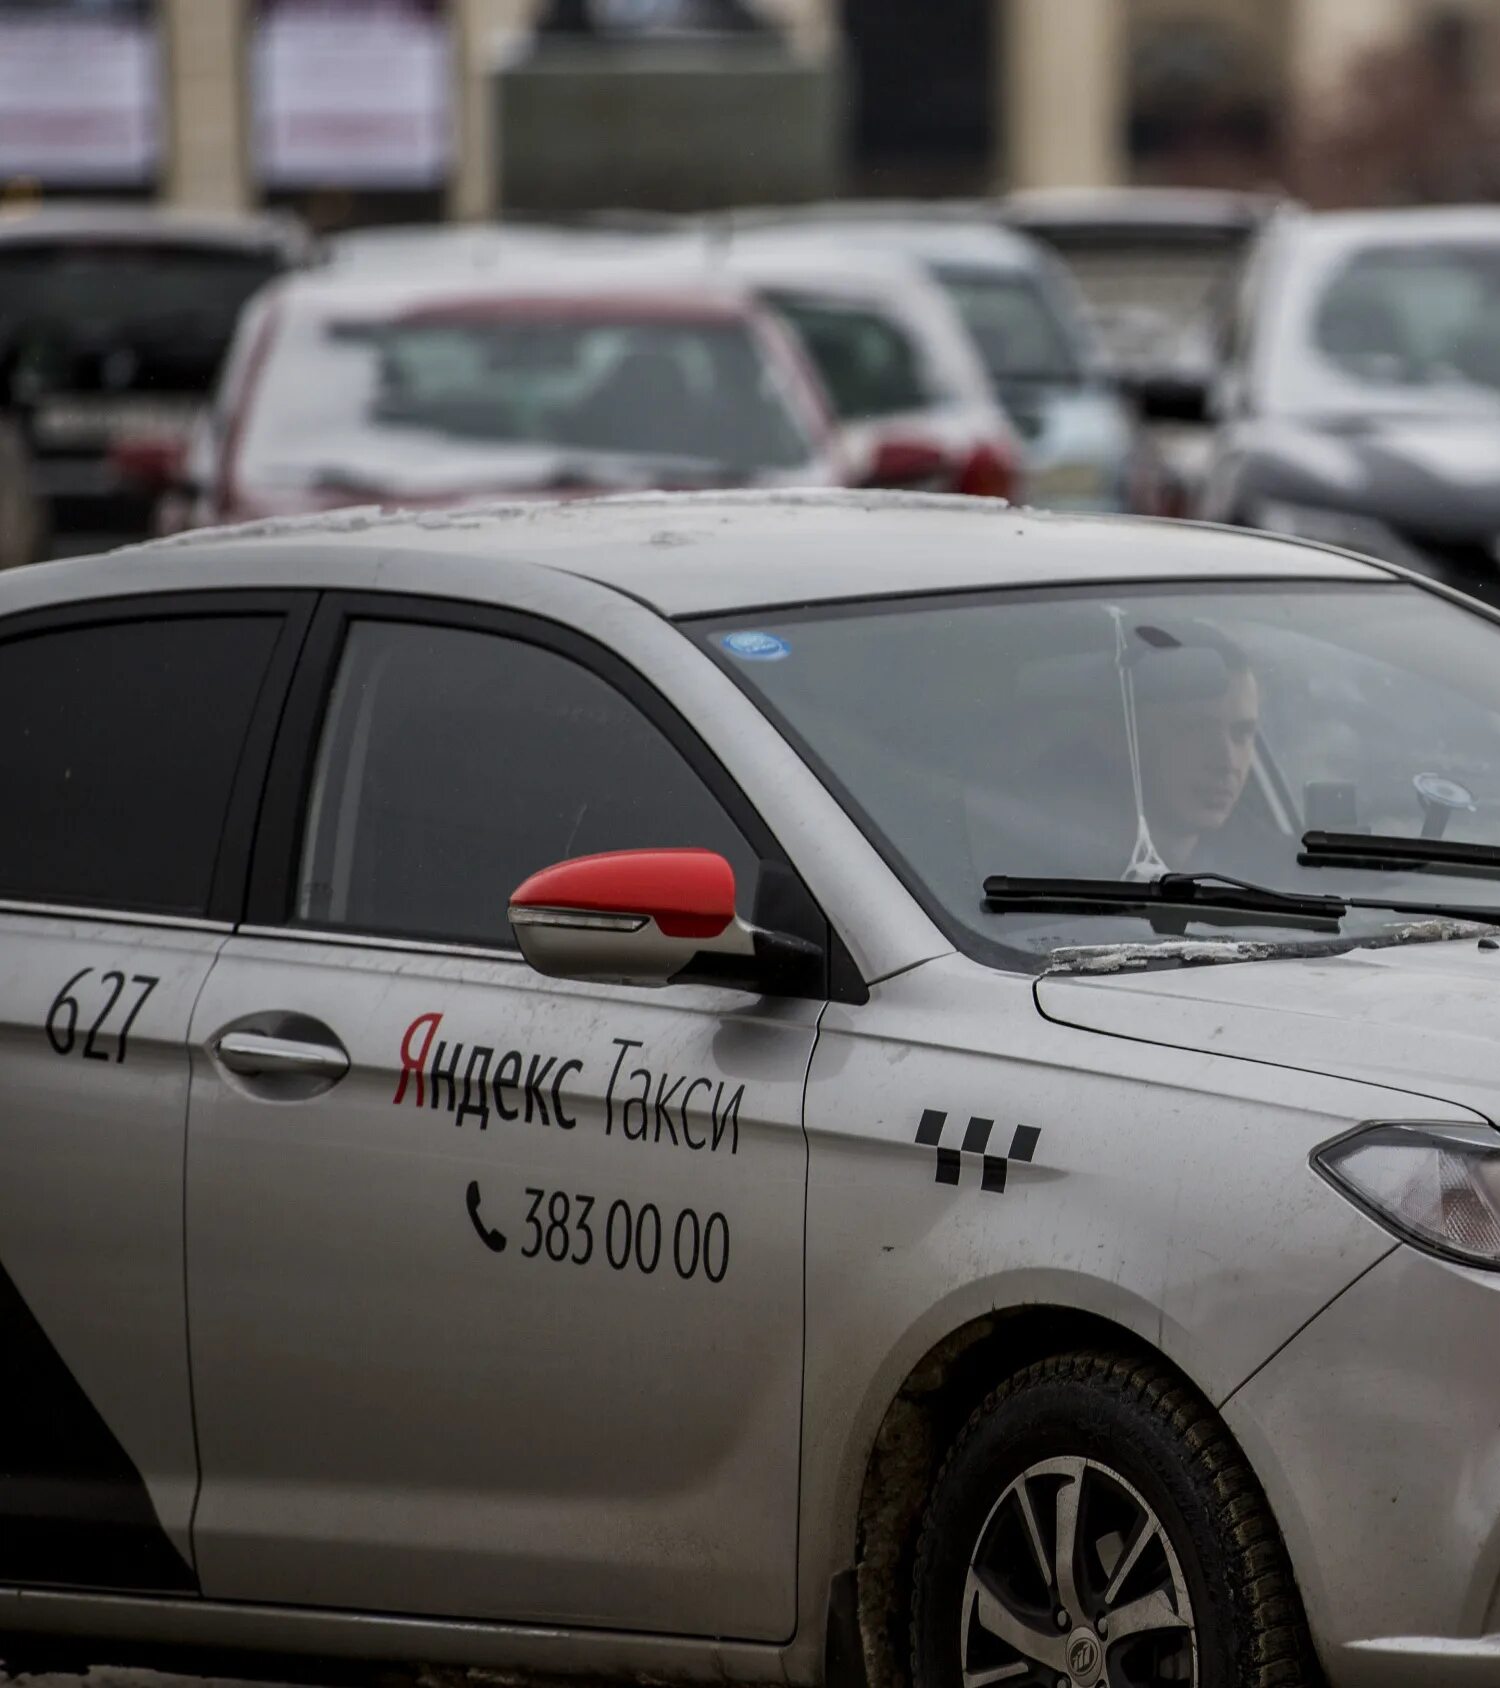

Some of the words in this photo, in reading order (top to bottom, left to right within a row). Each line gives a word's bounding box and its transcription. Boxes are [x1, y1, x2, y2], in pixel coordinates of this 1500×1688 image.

[46, 966, 160, 1063] 627
[394, 1013, 583, 1131] Яндекс
[605, 1038, 746, 1155] Такси
[521, 1188, 596, 1266] 383
[605, 1199, 662, 1275] 00
[674, 1207, 730, 1284] 00
